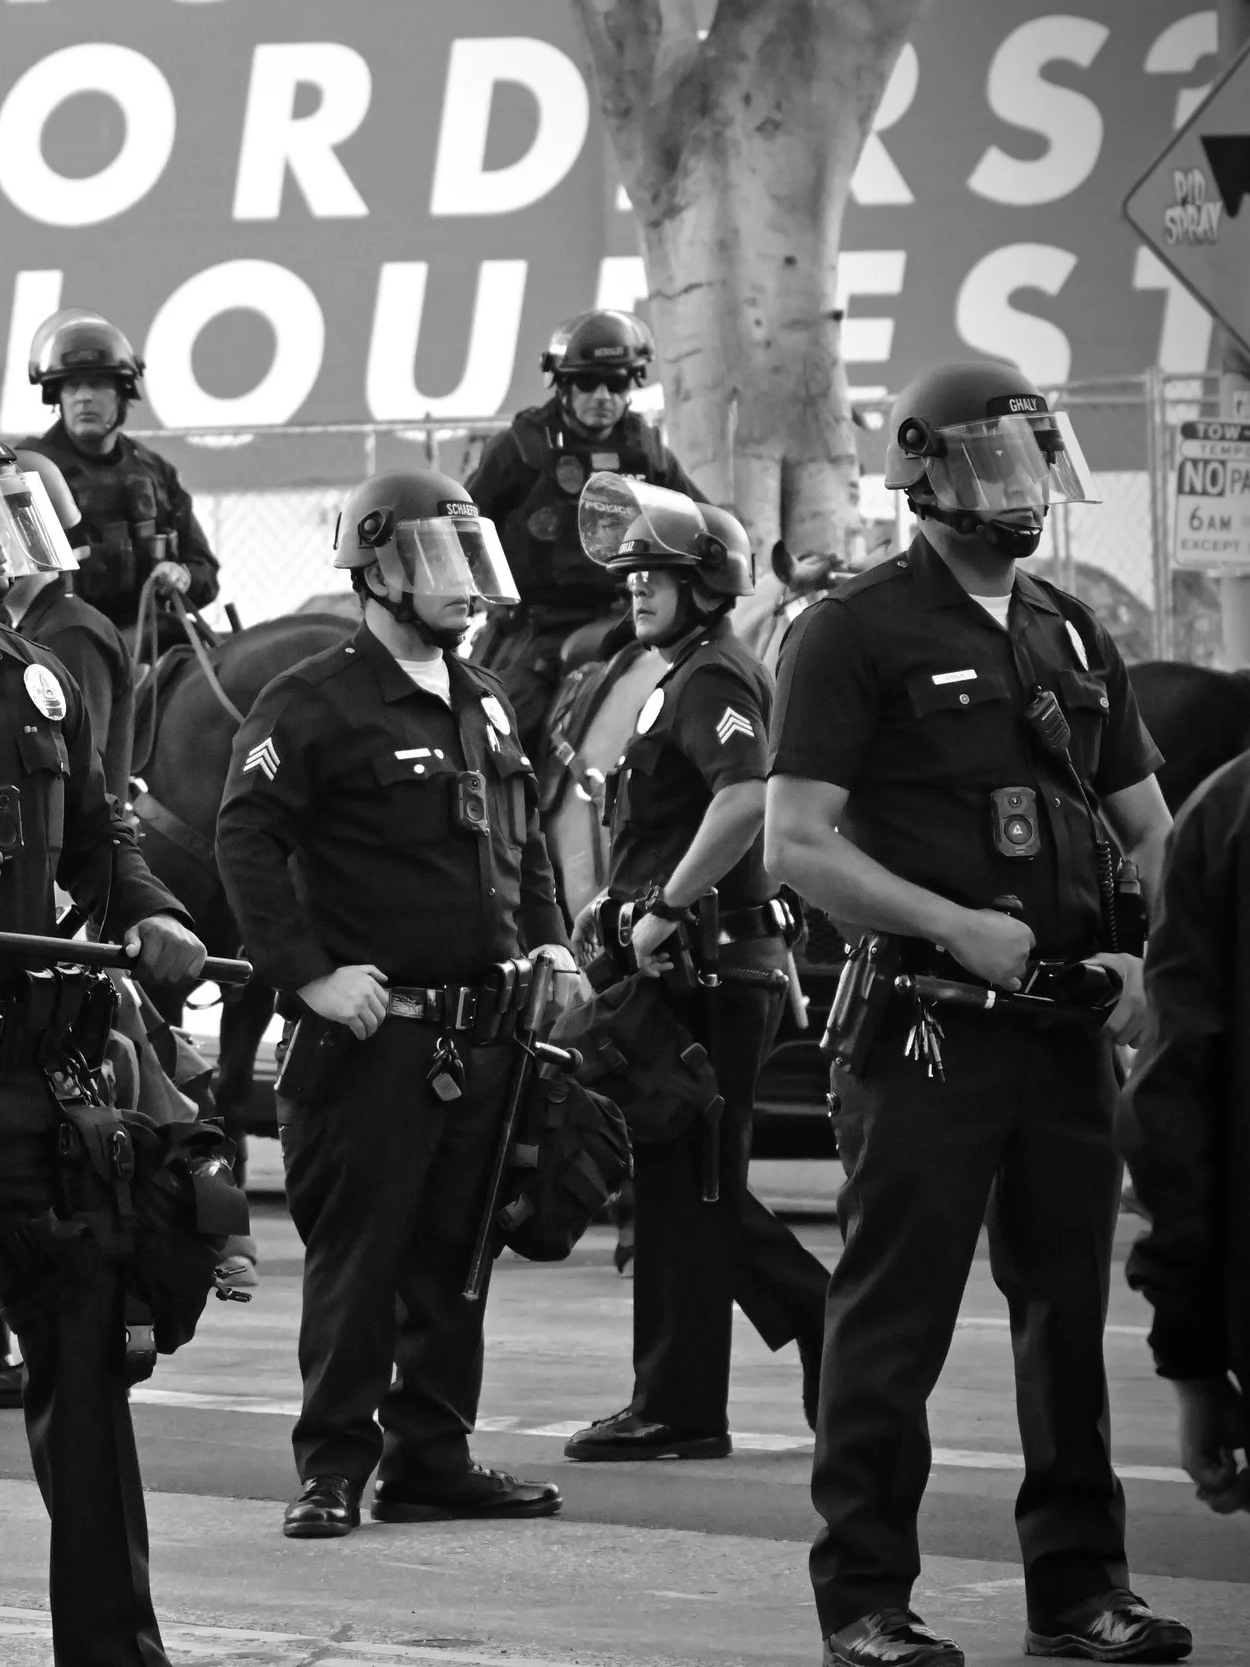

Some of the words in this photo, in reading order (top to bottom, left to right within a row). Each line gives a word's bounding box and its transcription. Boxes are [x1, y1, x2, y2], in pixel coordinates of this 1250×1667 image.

[1009, 398, 1038, 412] GHALY
[1183, 460, 1224, 495] NO
[1181, 537, 1240, 553] EXCEPT
